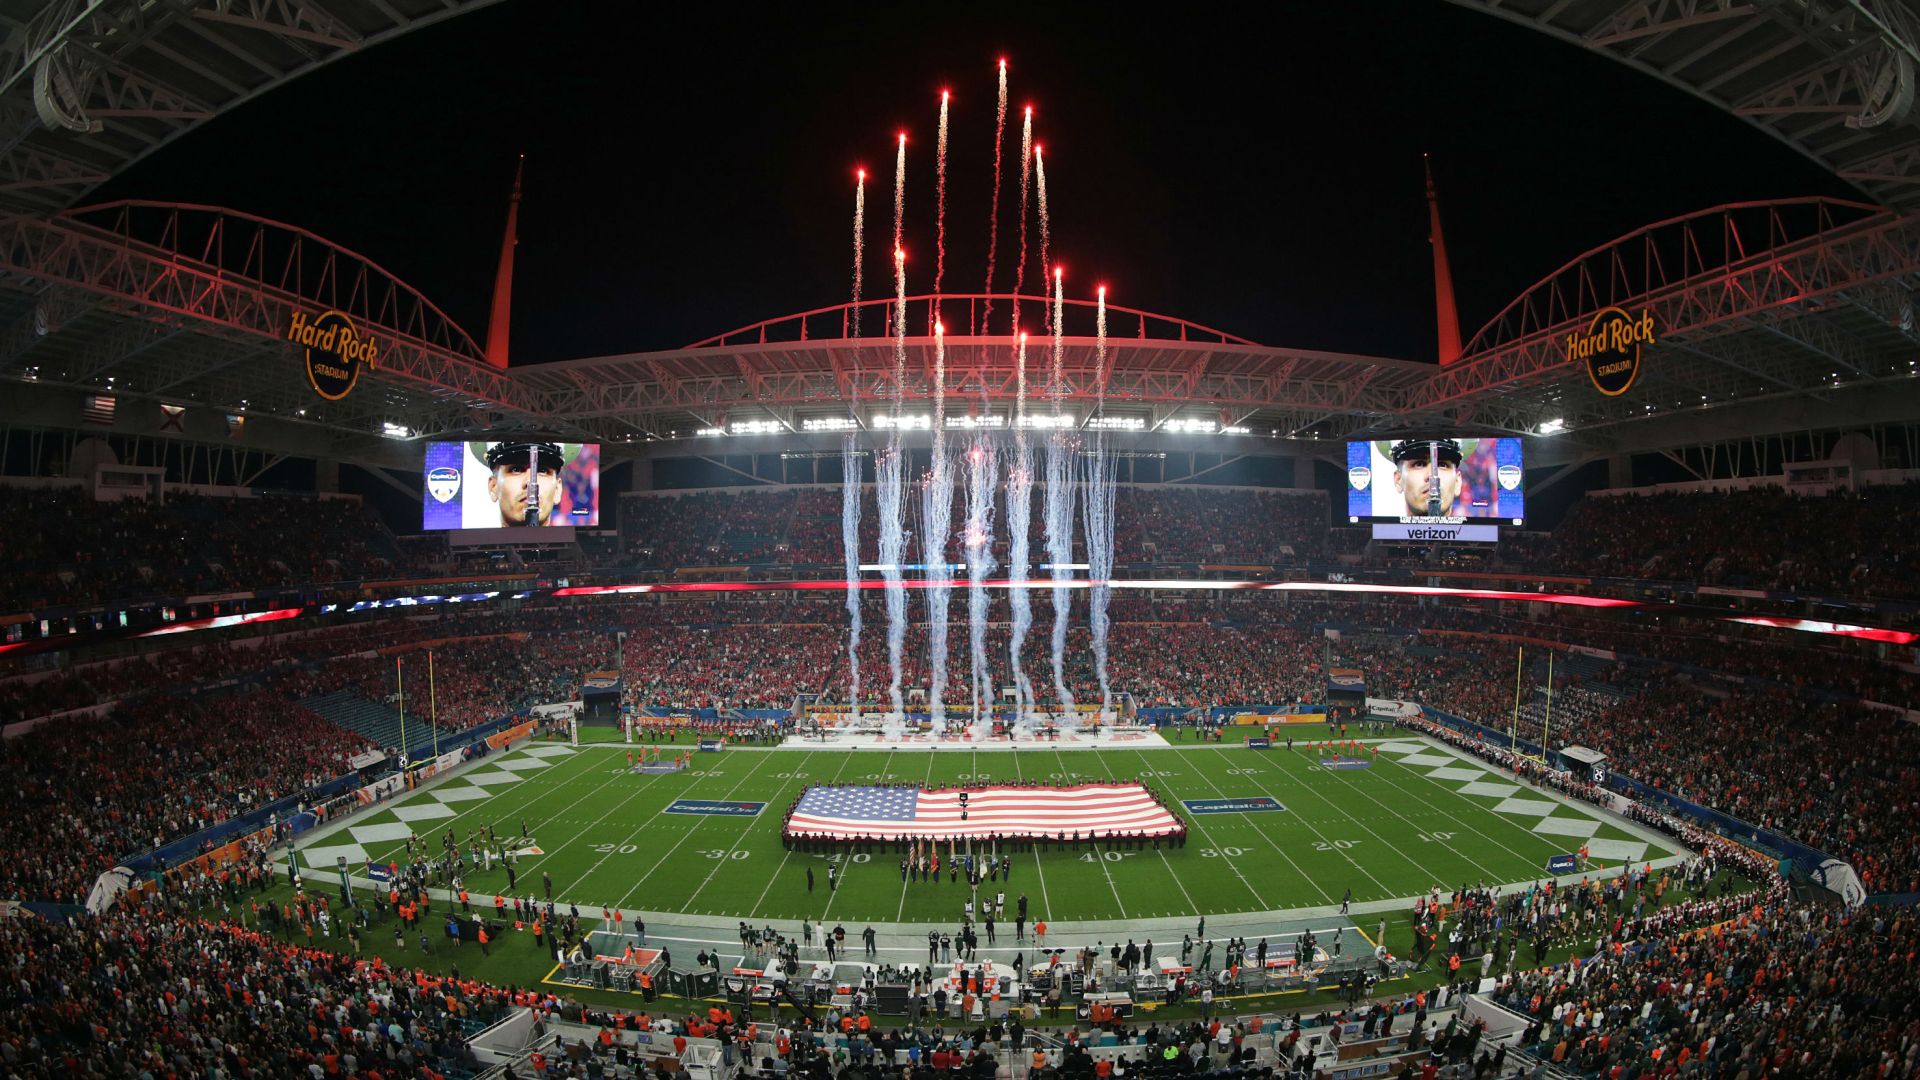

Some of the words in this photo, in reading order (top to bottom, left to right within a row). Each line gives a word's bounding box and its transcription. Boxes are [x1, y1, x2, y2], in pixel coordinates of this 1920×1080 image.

[288, 311, 338, 351] Hard
[336, 326, 378, 370] Rock
[1567, 322, 1607, 361] Hard
[1610, 308, 1656, 353] Rock
[314, 363, 349, 380] STADIUM
[1598, 360, 1632, 376] STADIUM
[1407, 526, 1456, 540] verizon
